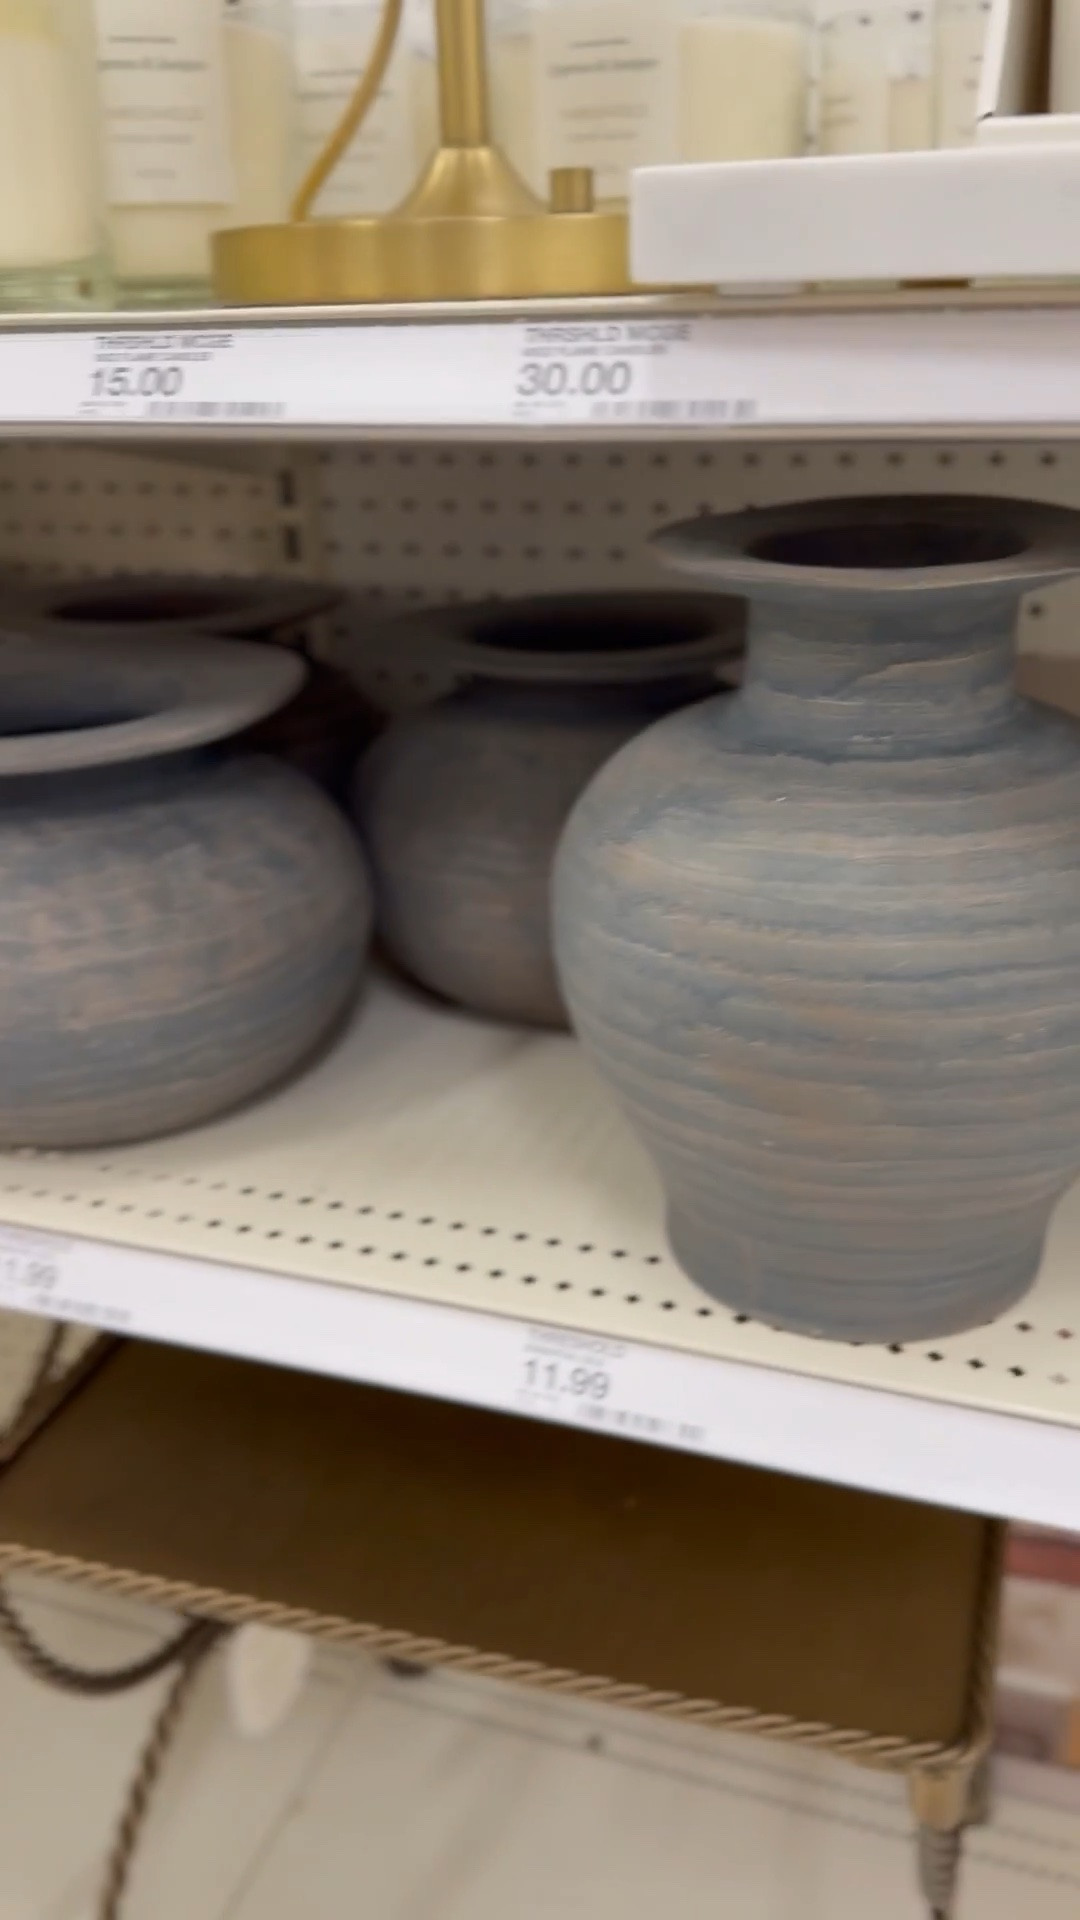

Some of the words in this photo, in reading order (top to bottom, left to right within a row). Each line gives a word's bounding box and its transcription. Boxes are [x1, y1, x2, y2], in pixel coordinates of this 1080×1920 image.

[91, 366, 183, 396] 15.00
[516, 361, 632, 396] 30.00
[526, 1359, 609, 1400] 11.99
